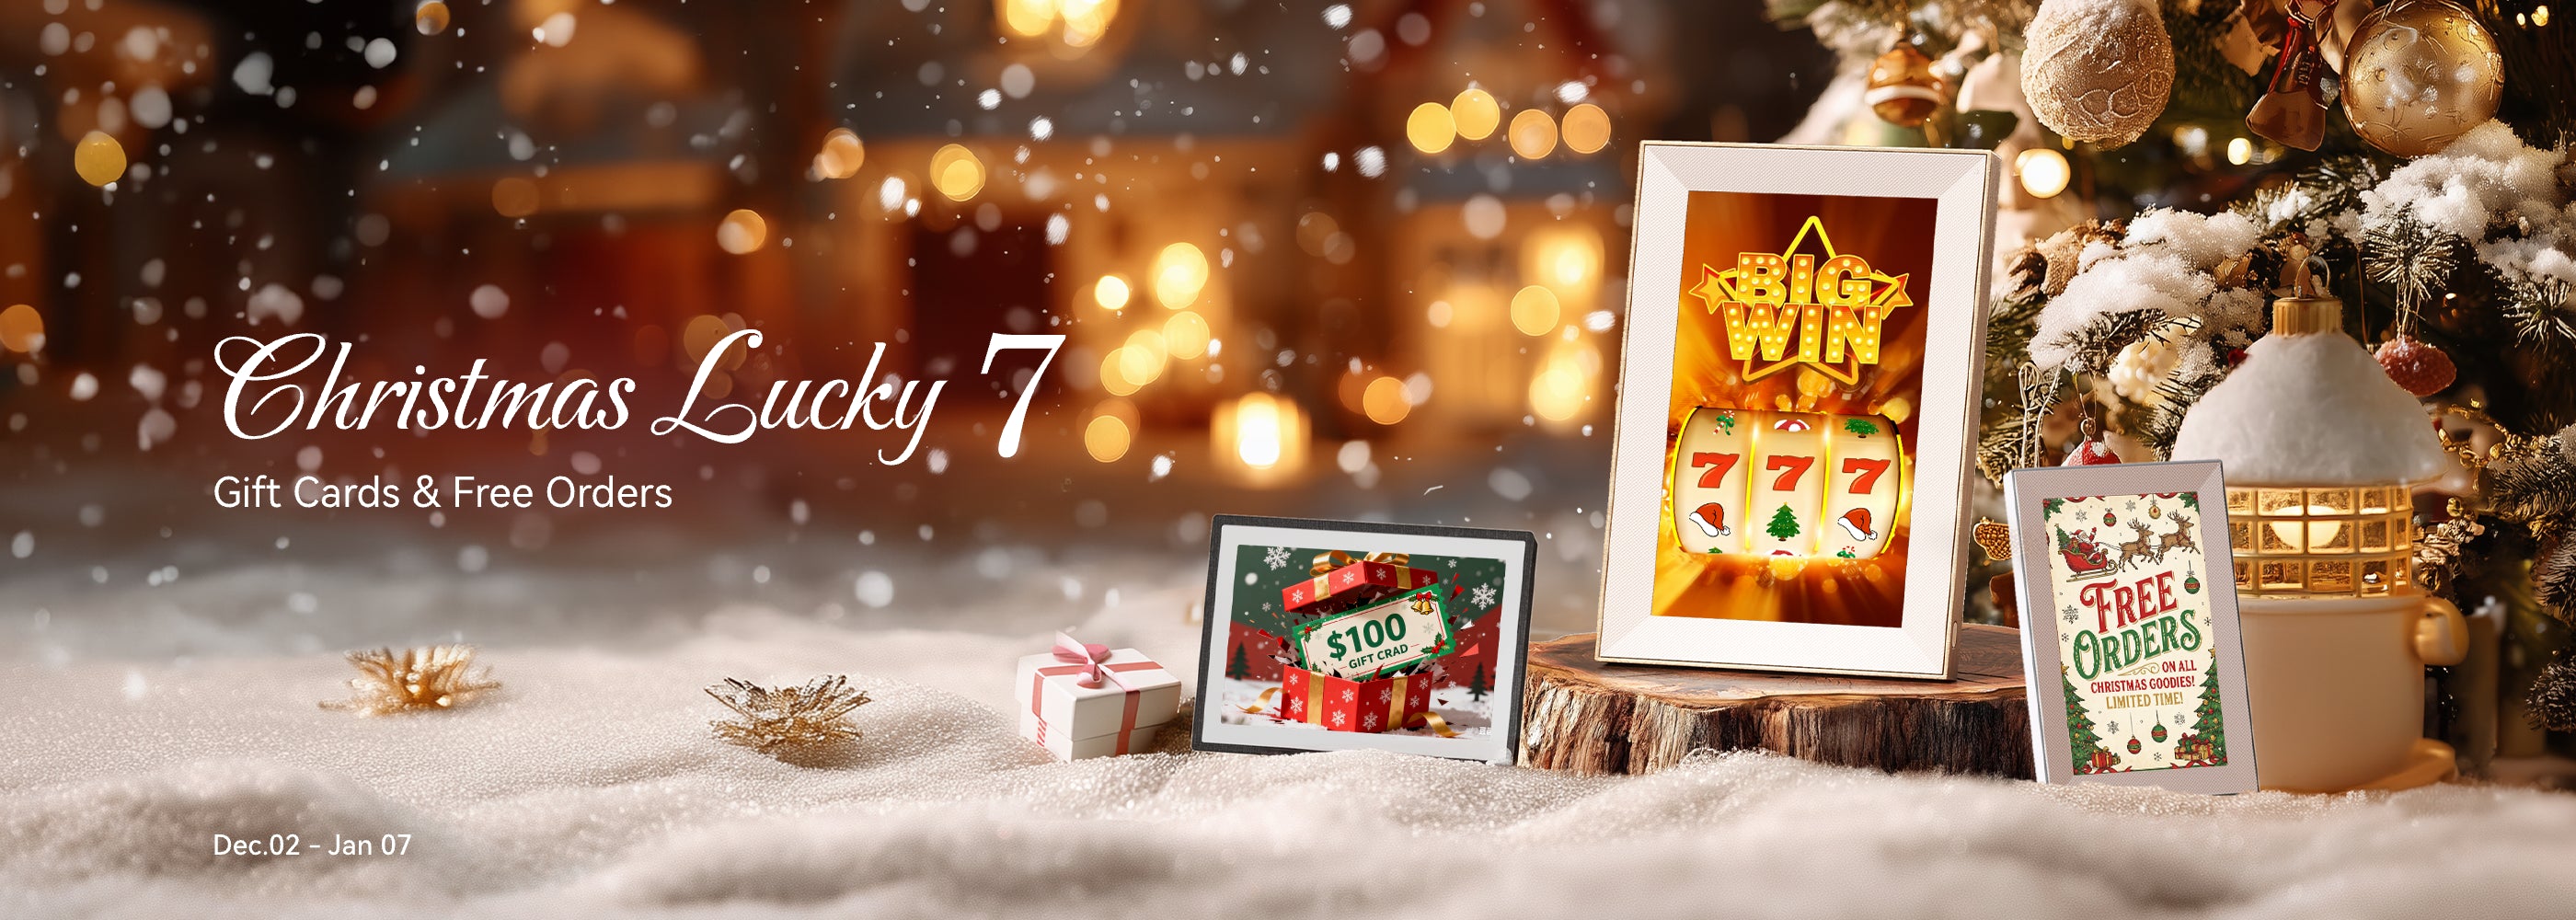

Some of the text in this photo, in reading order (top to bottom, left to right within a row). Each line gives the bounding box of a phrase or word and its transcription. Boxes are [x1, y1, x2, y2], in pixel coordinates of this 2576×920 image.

[1736, 252, 1873, 309] BIG
[1722, 300, 1883, 365] WIN
[1691, 452, 1892, 494] 7 7 7
[2079, 570, 2178, 634] FREE
[1327, 613, 1407, 661] $100
[1349, 644, 1409, 669] GIFT CRAD
[2073, 609, 2202, 680] ORDERS
[2090, 675, 2195, 694] CHRISTMAS GOODIES!
[2161, 660, 2197, 673] ON ALL
[2106, 691, 2184, 709] LIMITED TIME!
